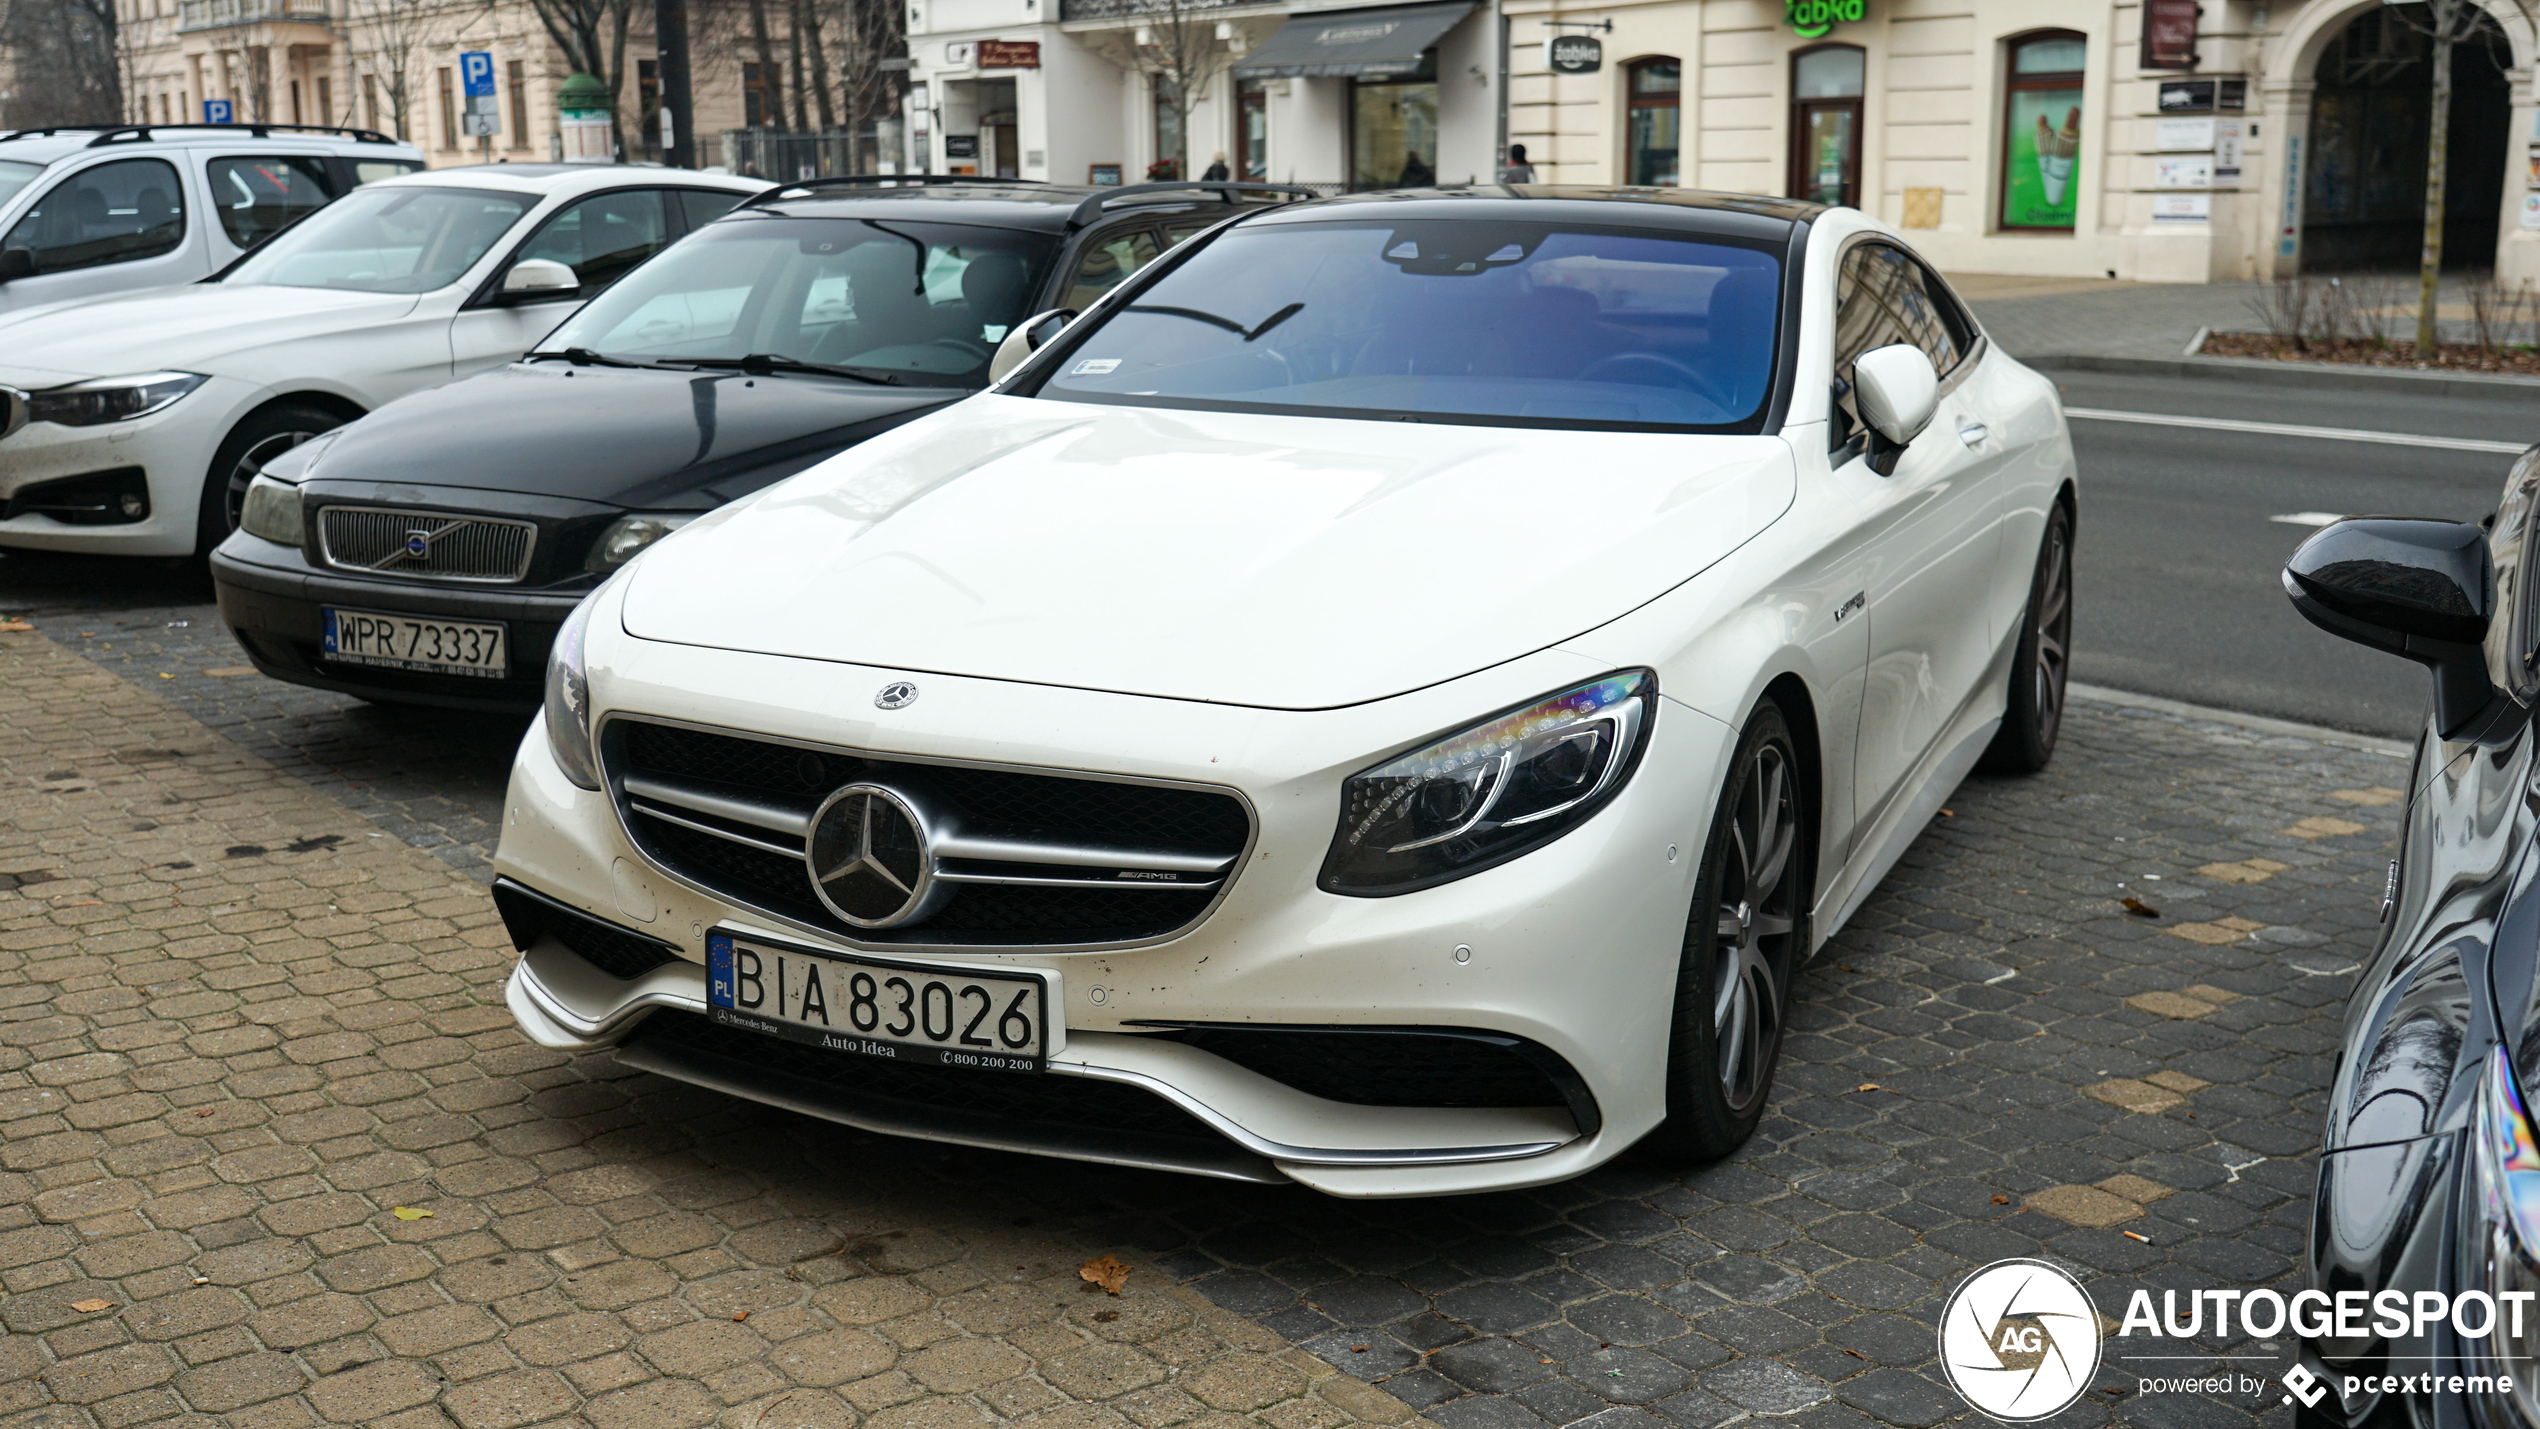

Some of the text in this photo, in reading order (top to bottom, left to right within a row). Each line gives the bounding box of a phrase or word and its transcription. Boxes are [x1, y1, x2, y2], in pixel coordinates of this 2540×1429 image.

[467, 55, 488, 85] P
[210, 102, 228, 124] P
[325, 634, 337, 647] PL
[338, 614, 500, 666] WPR 73337
[1137, 872, 1177, 880] AMG
[714, 979, 732, 999] PL
[736, 946, 1032, 1049] BIA 83026
[821, 1033, 896, 1058] Auto Idea
[954, 1053, 1033, 1071] 800 200 200
